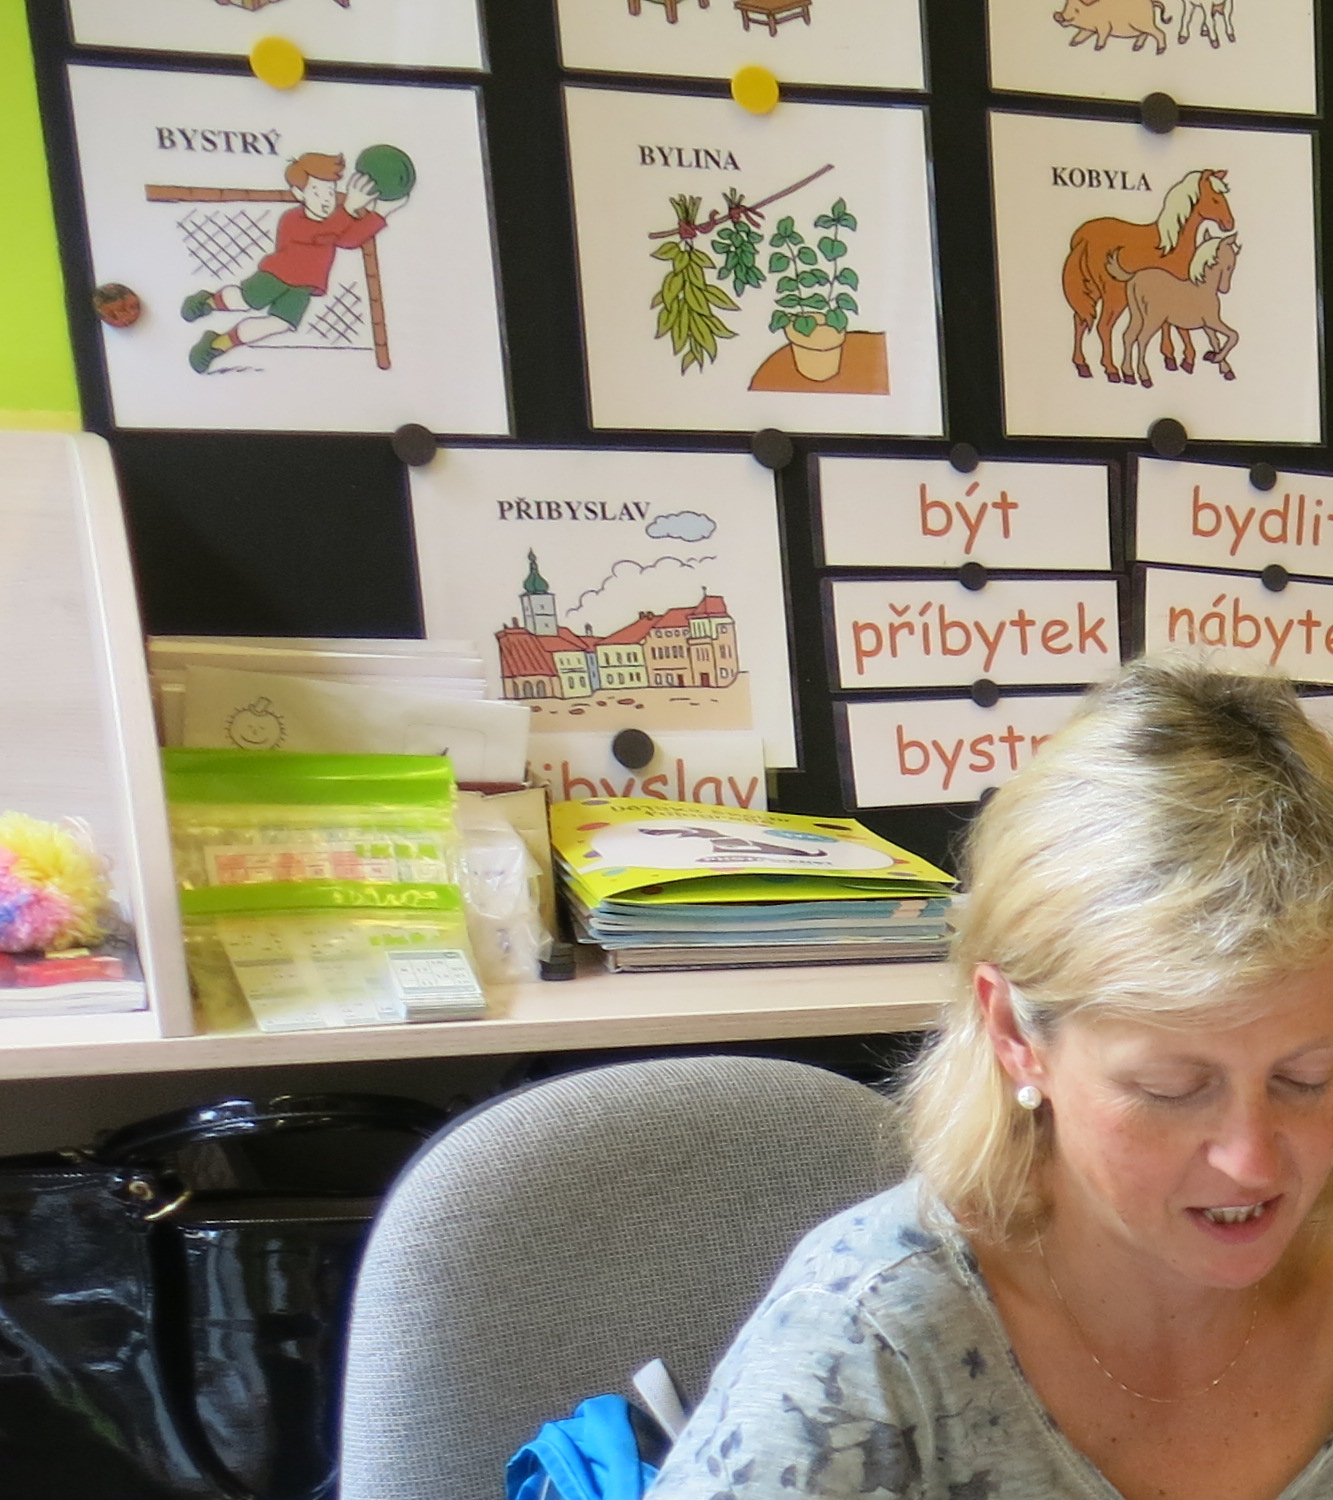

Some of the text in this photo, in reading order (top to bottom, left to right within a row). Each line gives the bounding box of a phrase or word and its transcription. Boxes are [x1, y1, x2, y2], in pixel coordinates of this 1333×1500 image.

[155, 125, 282, 157] BYSTRÝ
[639, 144, 742, 172] BYLINA
[1052, 166, 1152, 192] KOBYLA
[497, 496, 651, 523] PŘIBYSLAV
[918, 482, 1019, 555] být
[852, 602, 1109, 674] příbytek
[896, 724, 1050, 789] bystr
[532, 760, 759, 805] ibyslav
